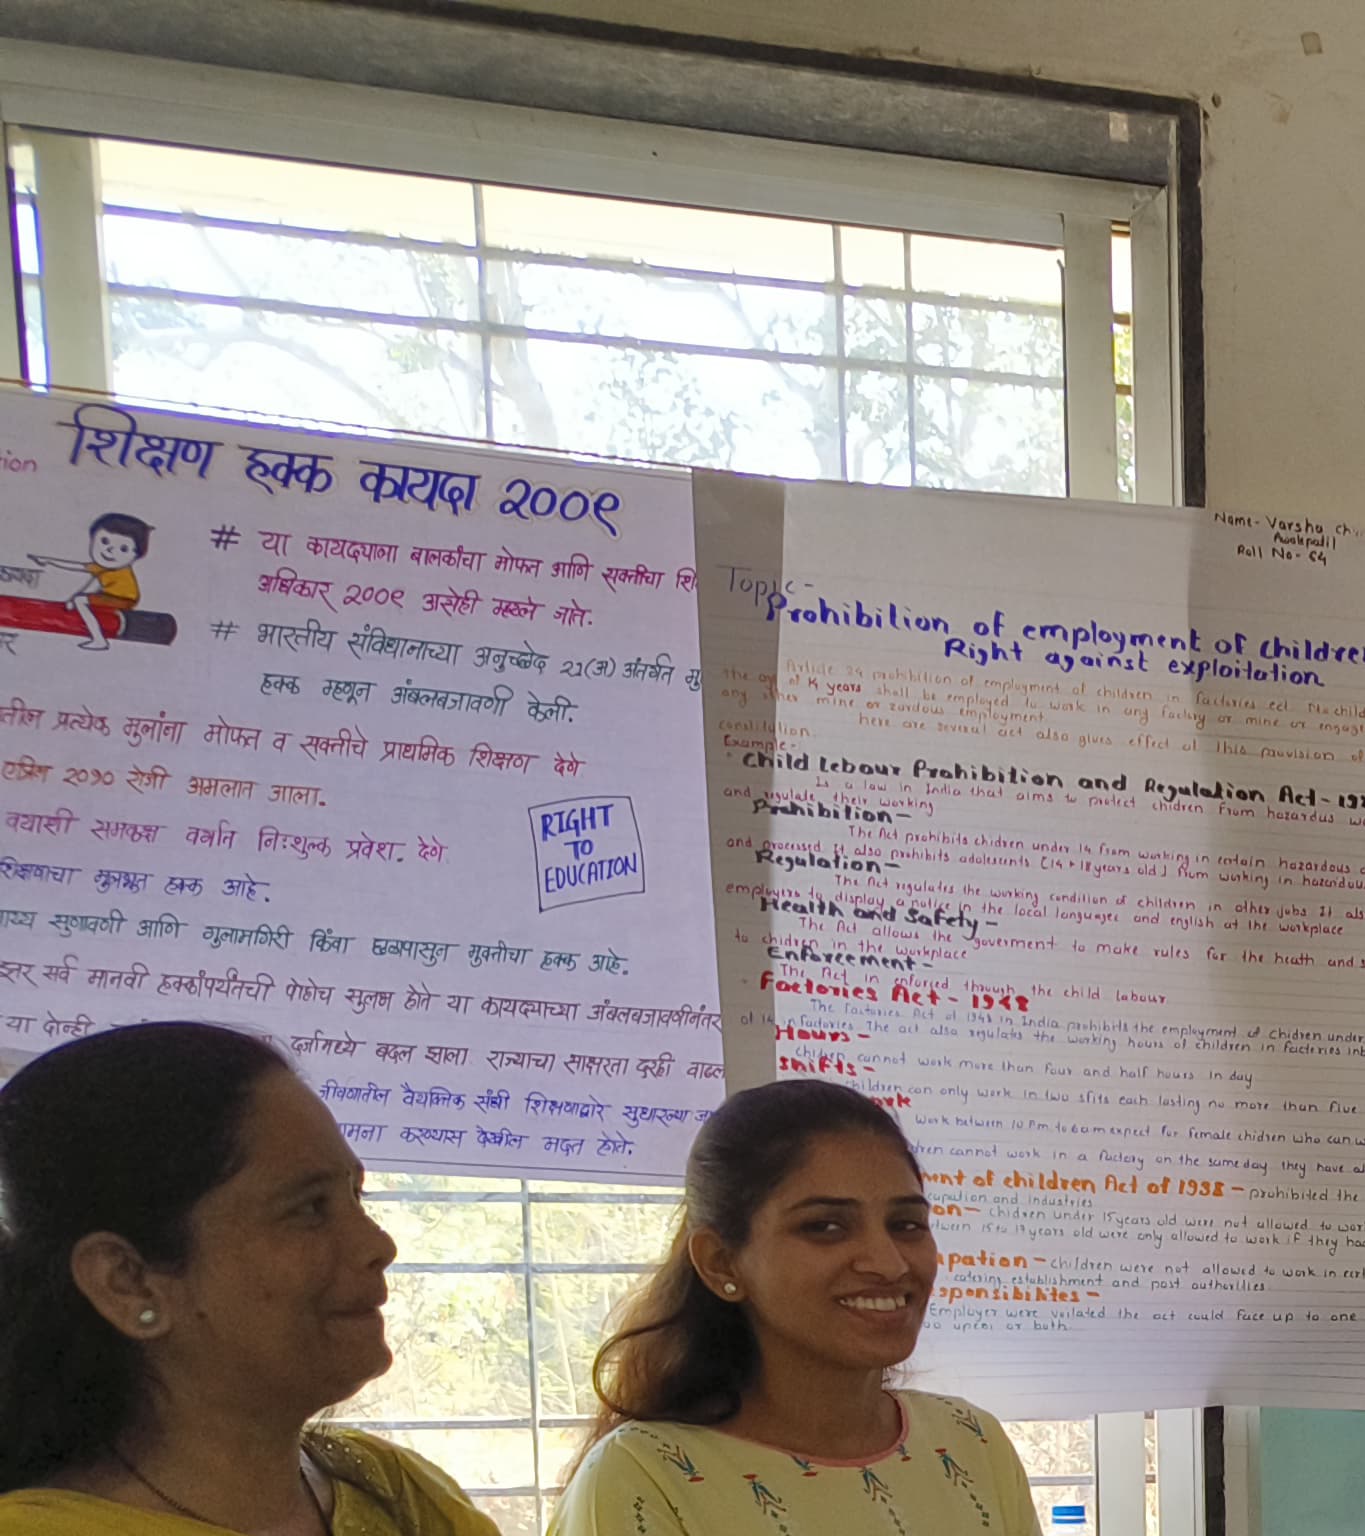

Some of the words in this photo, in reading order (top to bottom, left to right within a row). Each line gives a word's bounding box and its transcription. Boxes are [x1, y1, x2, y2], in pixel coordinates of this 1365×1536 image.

[56, 403, 224, 480] शिक्षण
[238, 444, 334, 495] हक्क
[499, 478, 621, 537] २००९
[973, 609, 1006, 638] of
[1022, 620, 1201, 652] employment
[1214, 633, 1248, 656] of
[943, 637, 1023, 666] Right
[1044, 650, 1150, 673] against
[1167, 658, 1325, 688] exploitation
[742, 751, 810, 773] Child
[912, 758, 1064, 789] Prohibition
[1078, 774, 1128, 792] and
[1145, 776, 1265, 803] Regulation
[541, 803, 614, 842] RIGHT
[564, 839, 594, 861] TO
[544, 852, 637, 894] EDUCATION
[853, 904, 897, 923] and
[1104, 1171, 1139, 1195] Act
